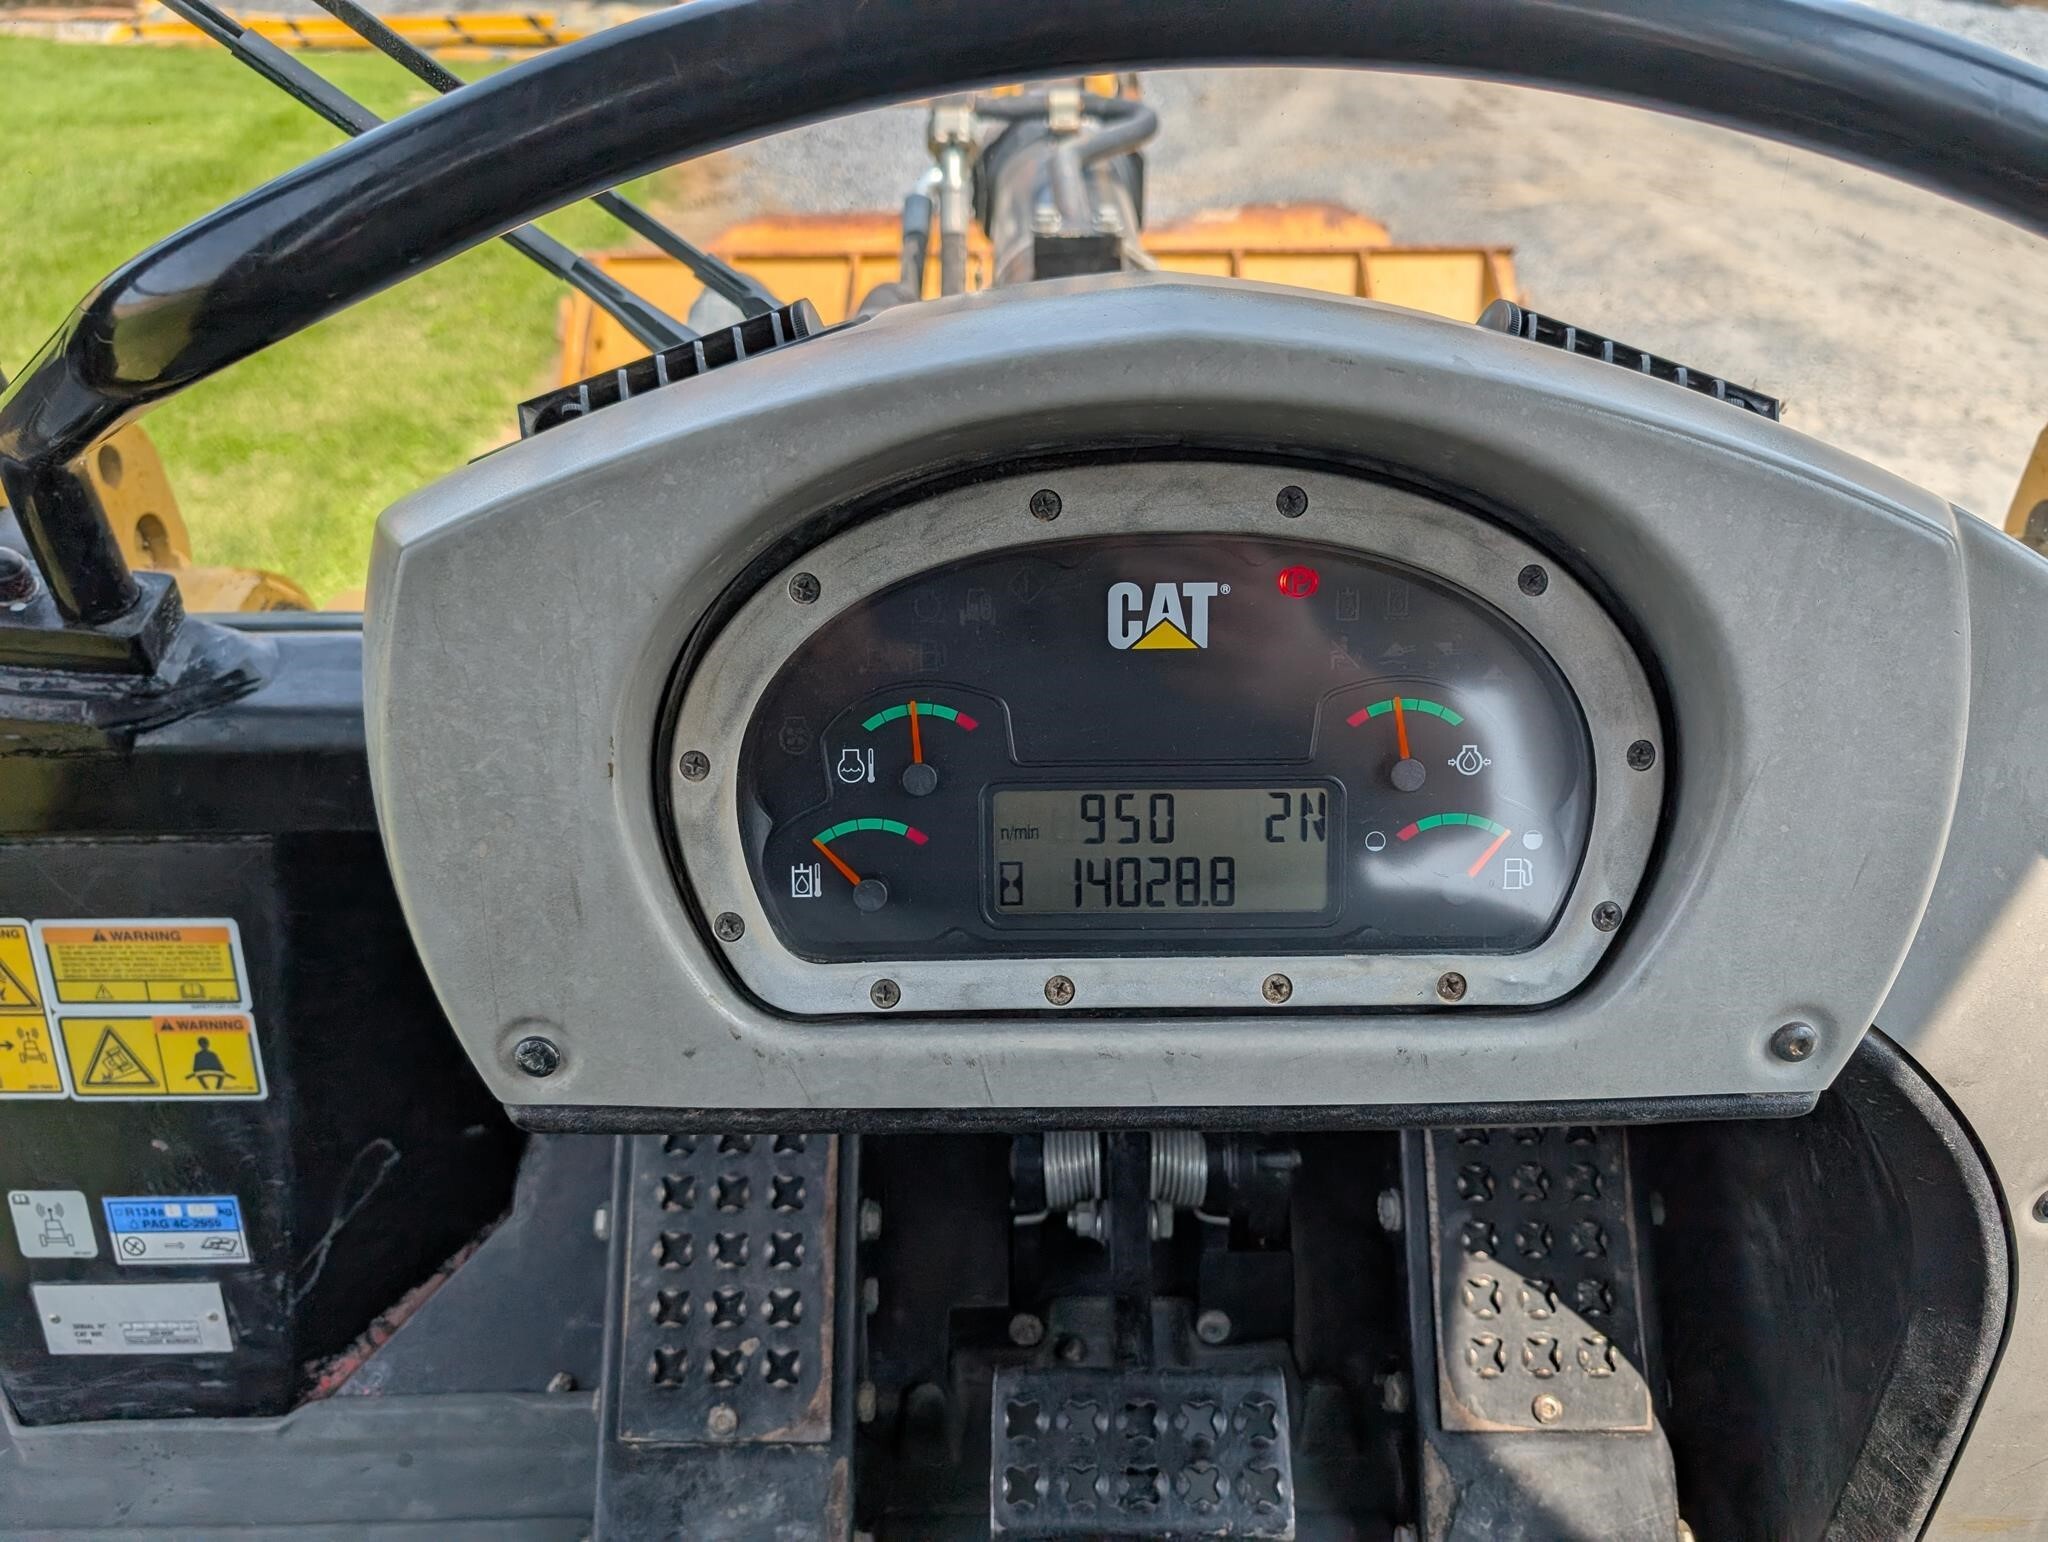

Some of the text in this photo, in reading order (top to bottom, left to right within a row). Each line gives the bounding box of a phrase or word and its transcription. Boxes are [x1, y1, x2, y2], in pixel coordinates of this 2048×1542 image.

[1081, 793, 1175, 845] 950
[1000, 823, 1040, 840] n/min
[1074, 856, 1236, 907] 14028.8
[109, 930, 182, 942] WARNING
[176, 1019, 244, 1031] WARNING
